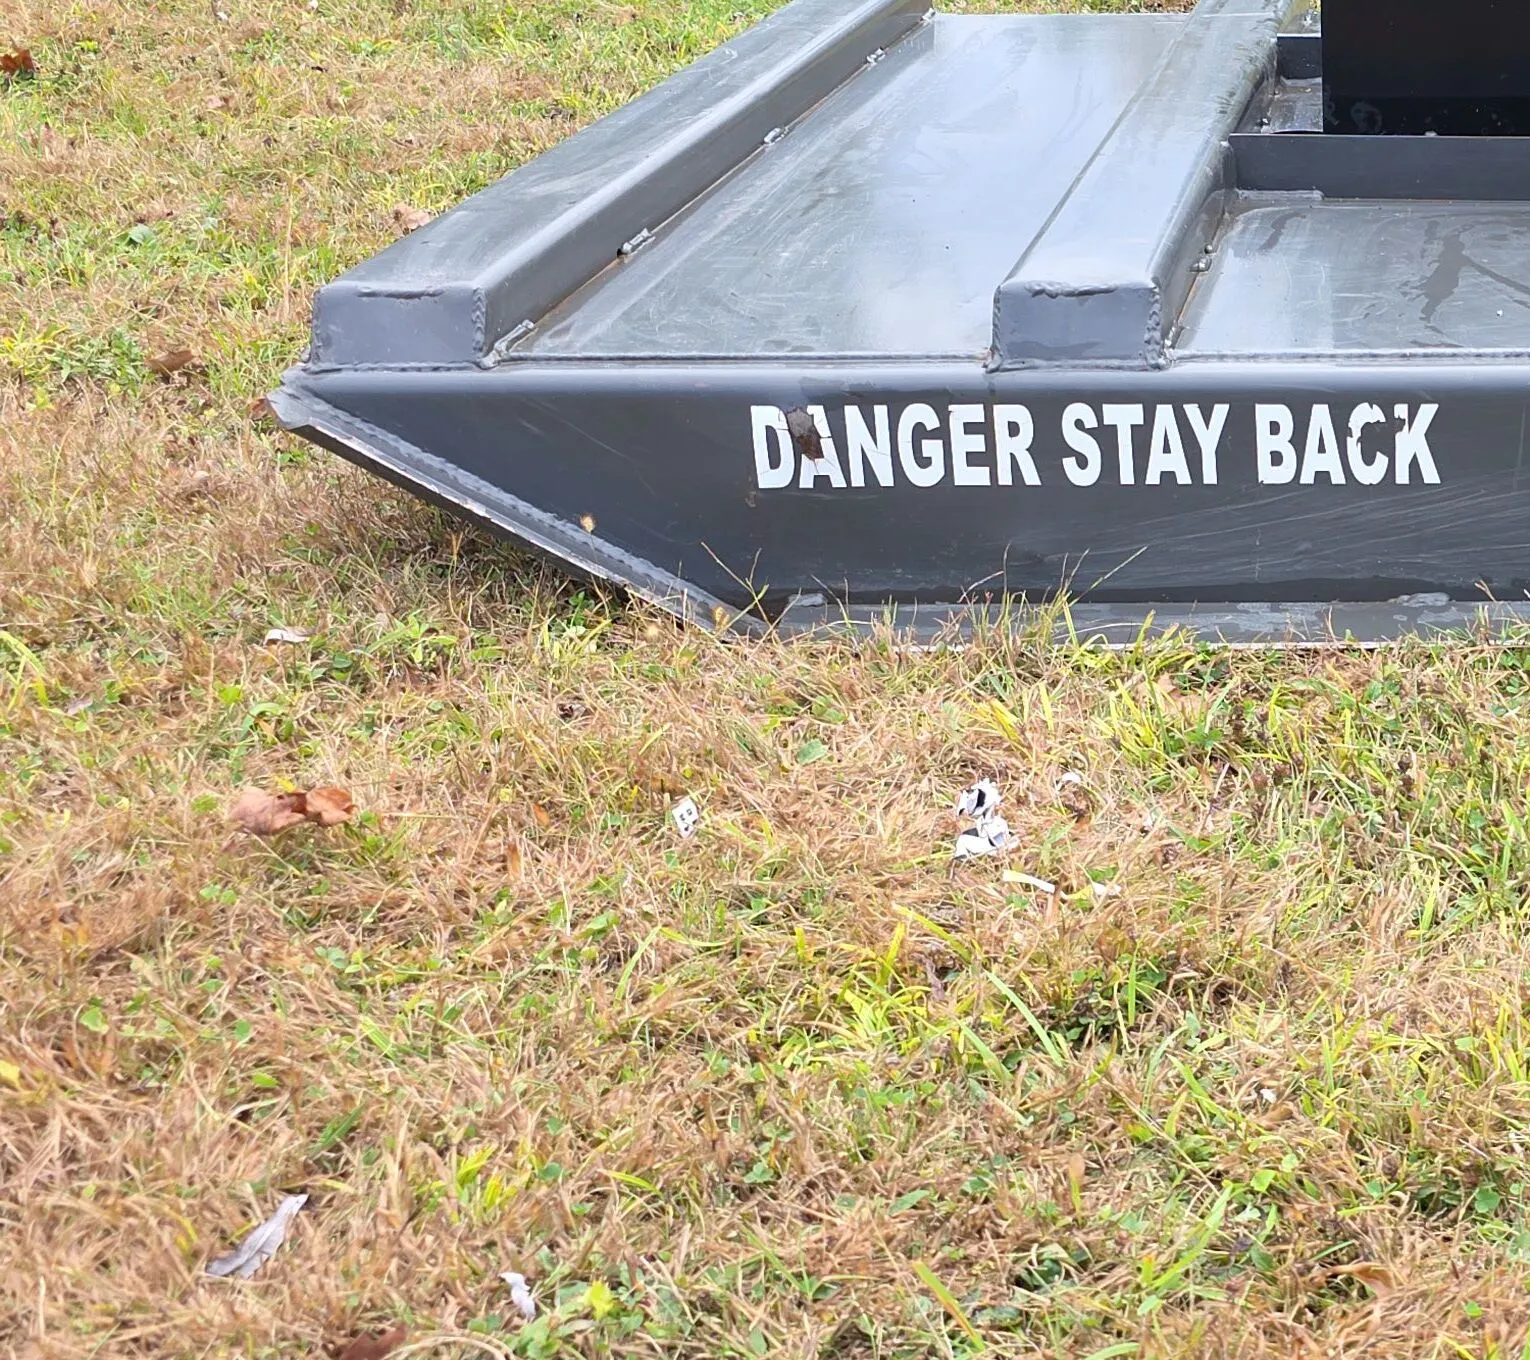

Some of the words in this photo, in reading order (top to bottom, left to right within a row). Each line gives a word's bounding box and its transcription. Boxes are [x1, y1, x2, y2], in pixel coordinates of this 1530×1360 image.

[750, 402, 1042, 489] DANGER
[1061, 401, 1231, 488] STAY
[1254, 402, 1442, 486] BACK
